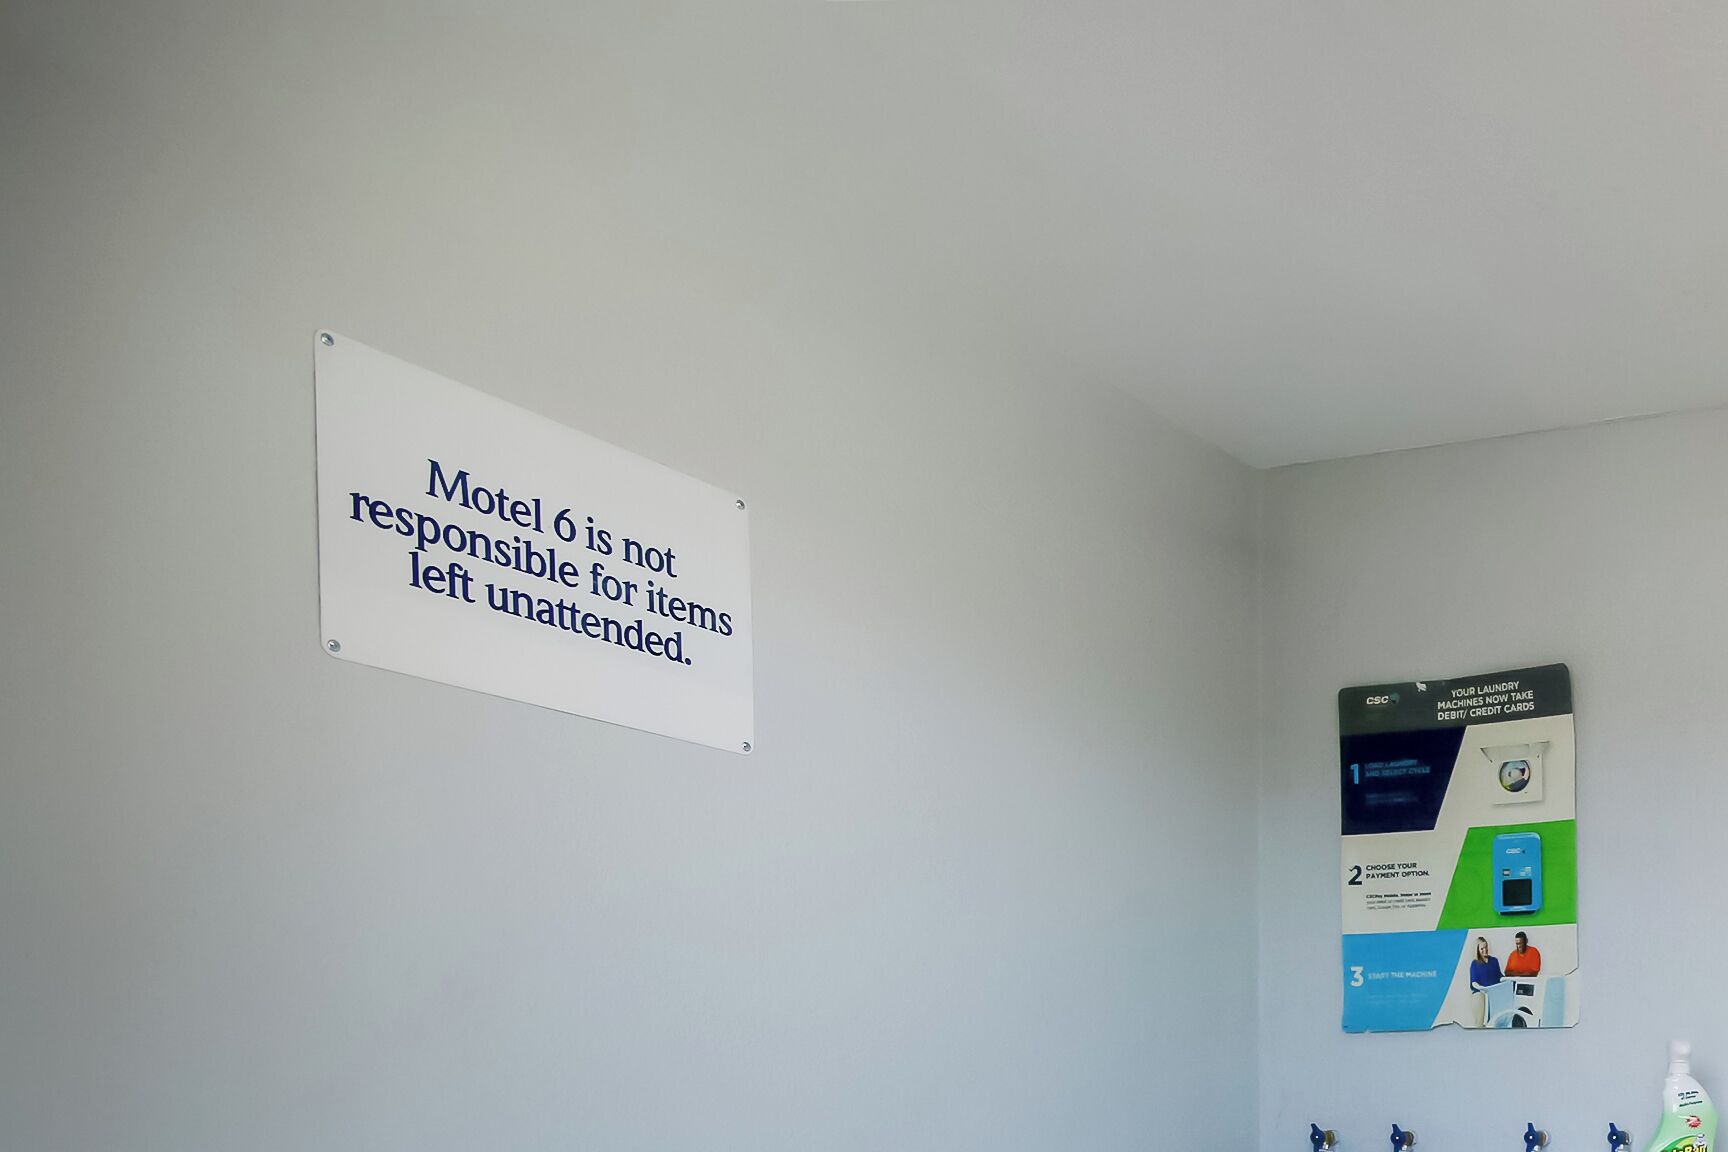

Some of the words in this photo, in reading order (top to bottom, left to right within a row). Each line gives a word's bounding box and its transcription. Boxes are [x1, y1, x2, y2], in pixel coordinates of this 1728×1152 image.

[426, 459, 543, 532] Motel
[553, 509, 576, 542] 6
[585, 517, 612, 555] is
[622, 537, 677, 577] not
[349, 491, 579, 587] responsible
[589, 563, 638, 606] for
[646, 581, 733, 636] items
[409, 551, 476, 602] left
[485, 584, 692, 666] unattended.
[1451, 686, 1475, 698] YOUR
[1478, 681, 1520, 695] LAUNDRY
[1366, 696, 1389, 705] CSC
[1437, 696, 1484, 710] MACHINES
[1485, 693, 1510, 704] NOW
[1511, 691, 1534, 701] TAKE
[1437, 709, 1467, 720] DEBIT/
[1469, 705, 1502, 717] CREDIT
[1504, 702, 1535, 713] CARDS
[1350, 763, 1359, 784] 1
[1348, 865, 1363, 885] 2
[1366, 863, 1395, 871] CHOOSE
[1397, 862, 1417, 870] YOUR
[1350, 966, 1364, 987] 3
[1405, 969, 1437, 978] MACHINE
